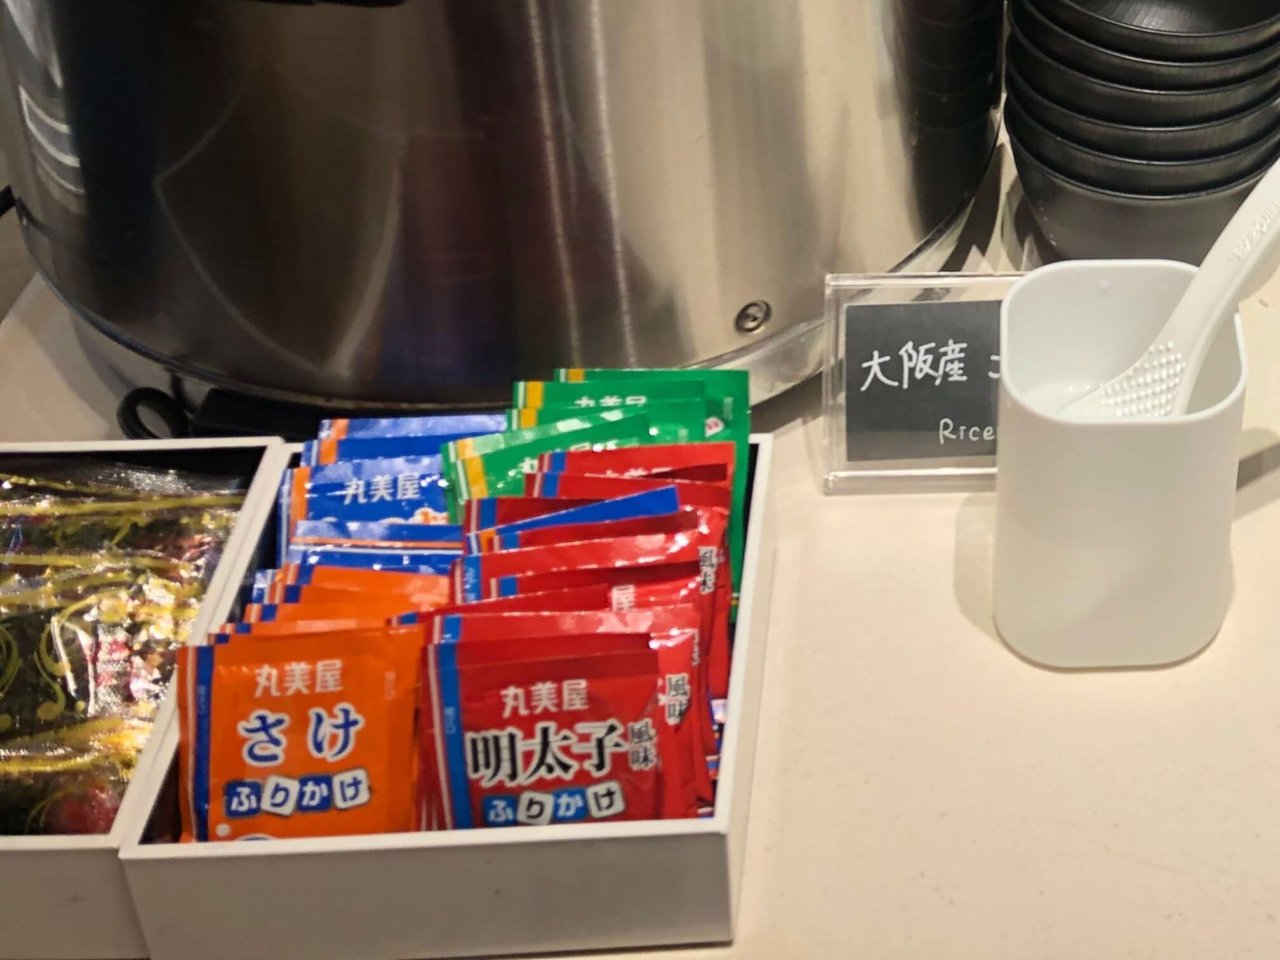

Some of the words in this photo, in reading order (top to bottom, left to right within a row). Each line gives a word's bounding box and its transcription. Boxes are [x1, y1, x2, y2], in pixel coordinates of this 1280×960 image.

[860, 338, 968, 392] 大阪産
[938, 418, 996, 444] Rice
[343, 472, 421, 505] 丸美屋
[254, 659, 344, 698] 丸美屋
[500, 679, 590, 719] 丸美屋
[238, 703, 364, 767] さけ
[466, 720, 629, 787] 明太子
[628, 718, 657, 770] 風味
[228, 772, 366, 815] ふりかけ
[486, 784, 620, 823] ふりかけ
